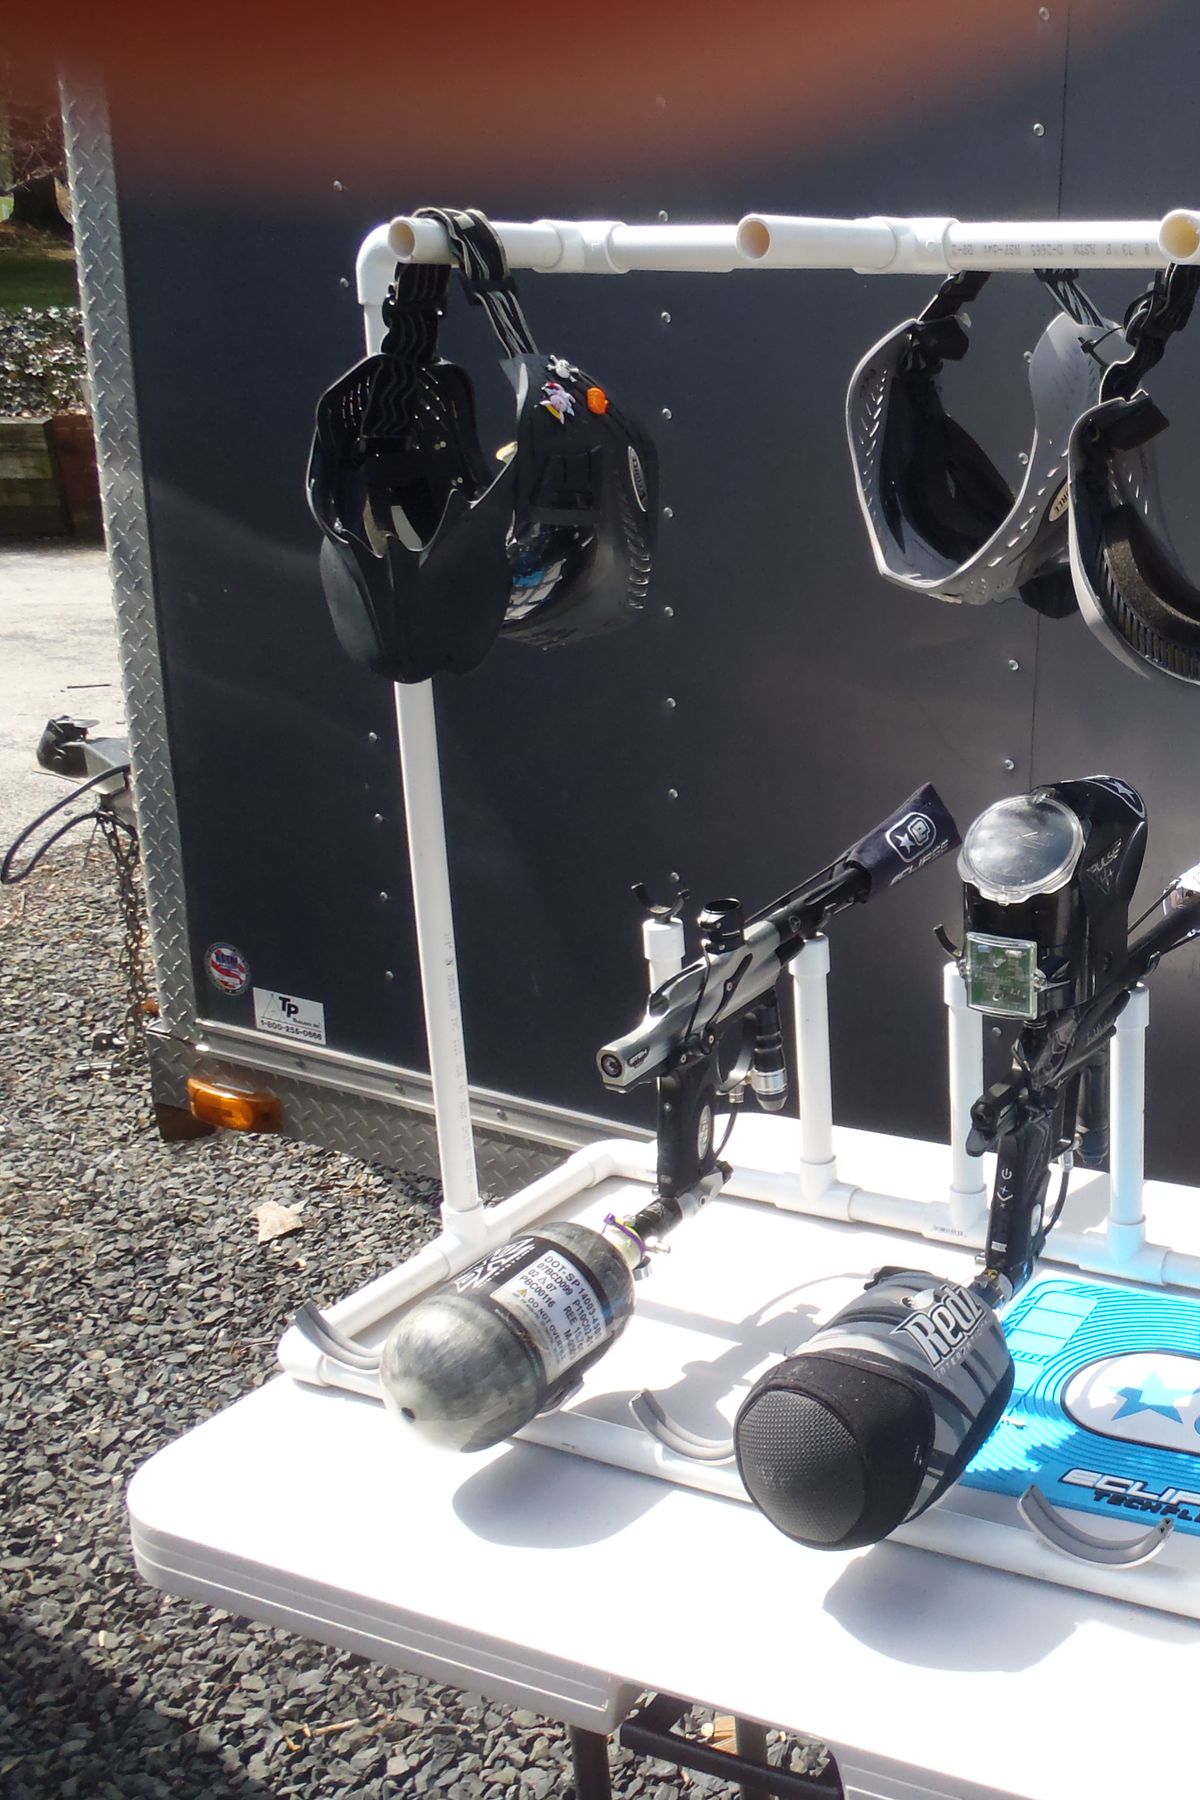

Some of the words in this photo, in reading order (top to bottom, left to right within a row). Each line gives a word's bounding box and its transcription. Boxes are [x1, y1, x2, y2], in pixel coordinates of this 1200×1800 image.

[544, 1255, 581, 1287] DOT-SP
[527, 1297, 539, 1309] DO
[538, 1307, 552, 1323] NOT
